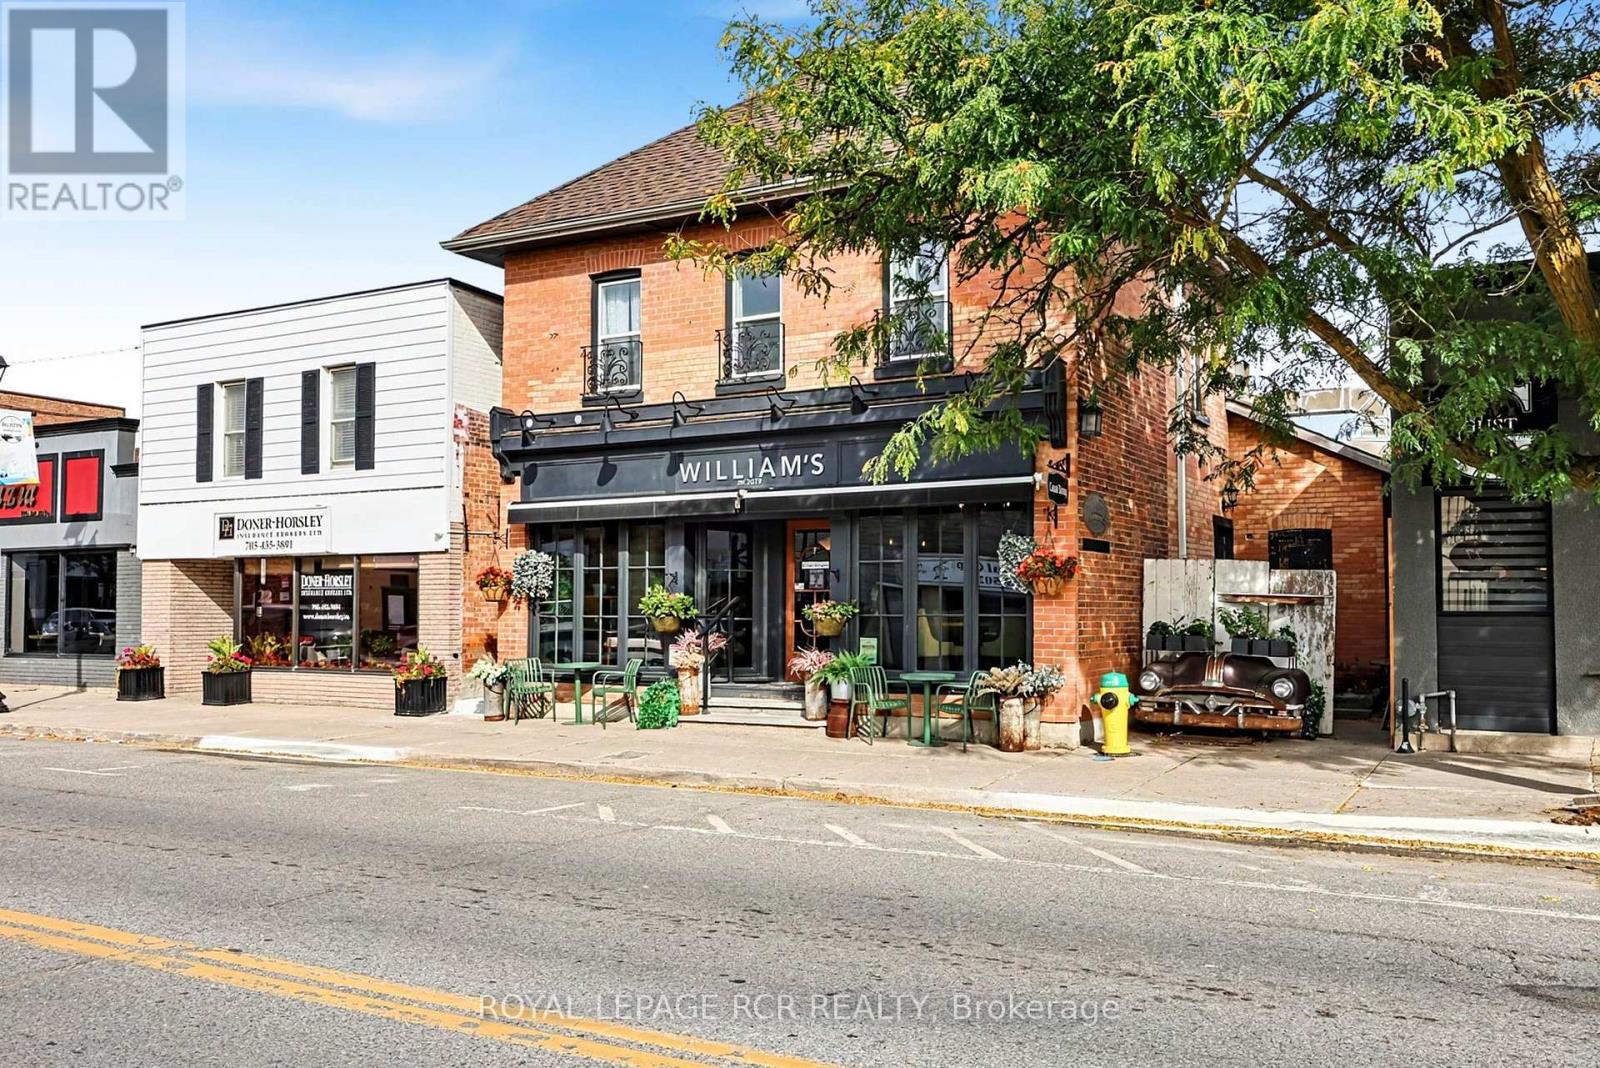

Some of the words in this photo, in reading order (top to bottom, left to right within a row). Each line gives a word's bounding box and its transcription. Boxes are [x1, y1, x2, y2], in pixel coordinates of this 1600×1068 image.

[679, 453, 825, 483] WILLIAM'S
[237, 515, 323, 530] DONER-HORSLEY
[301, 574, 352, 589] DONER-HORSLEY
